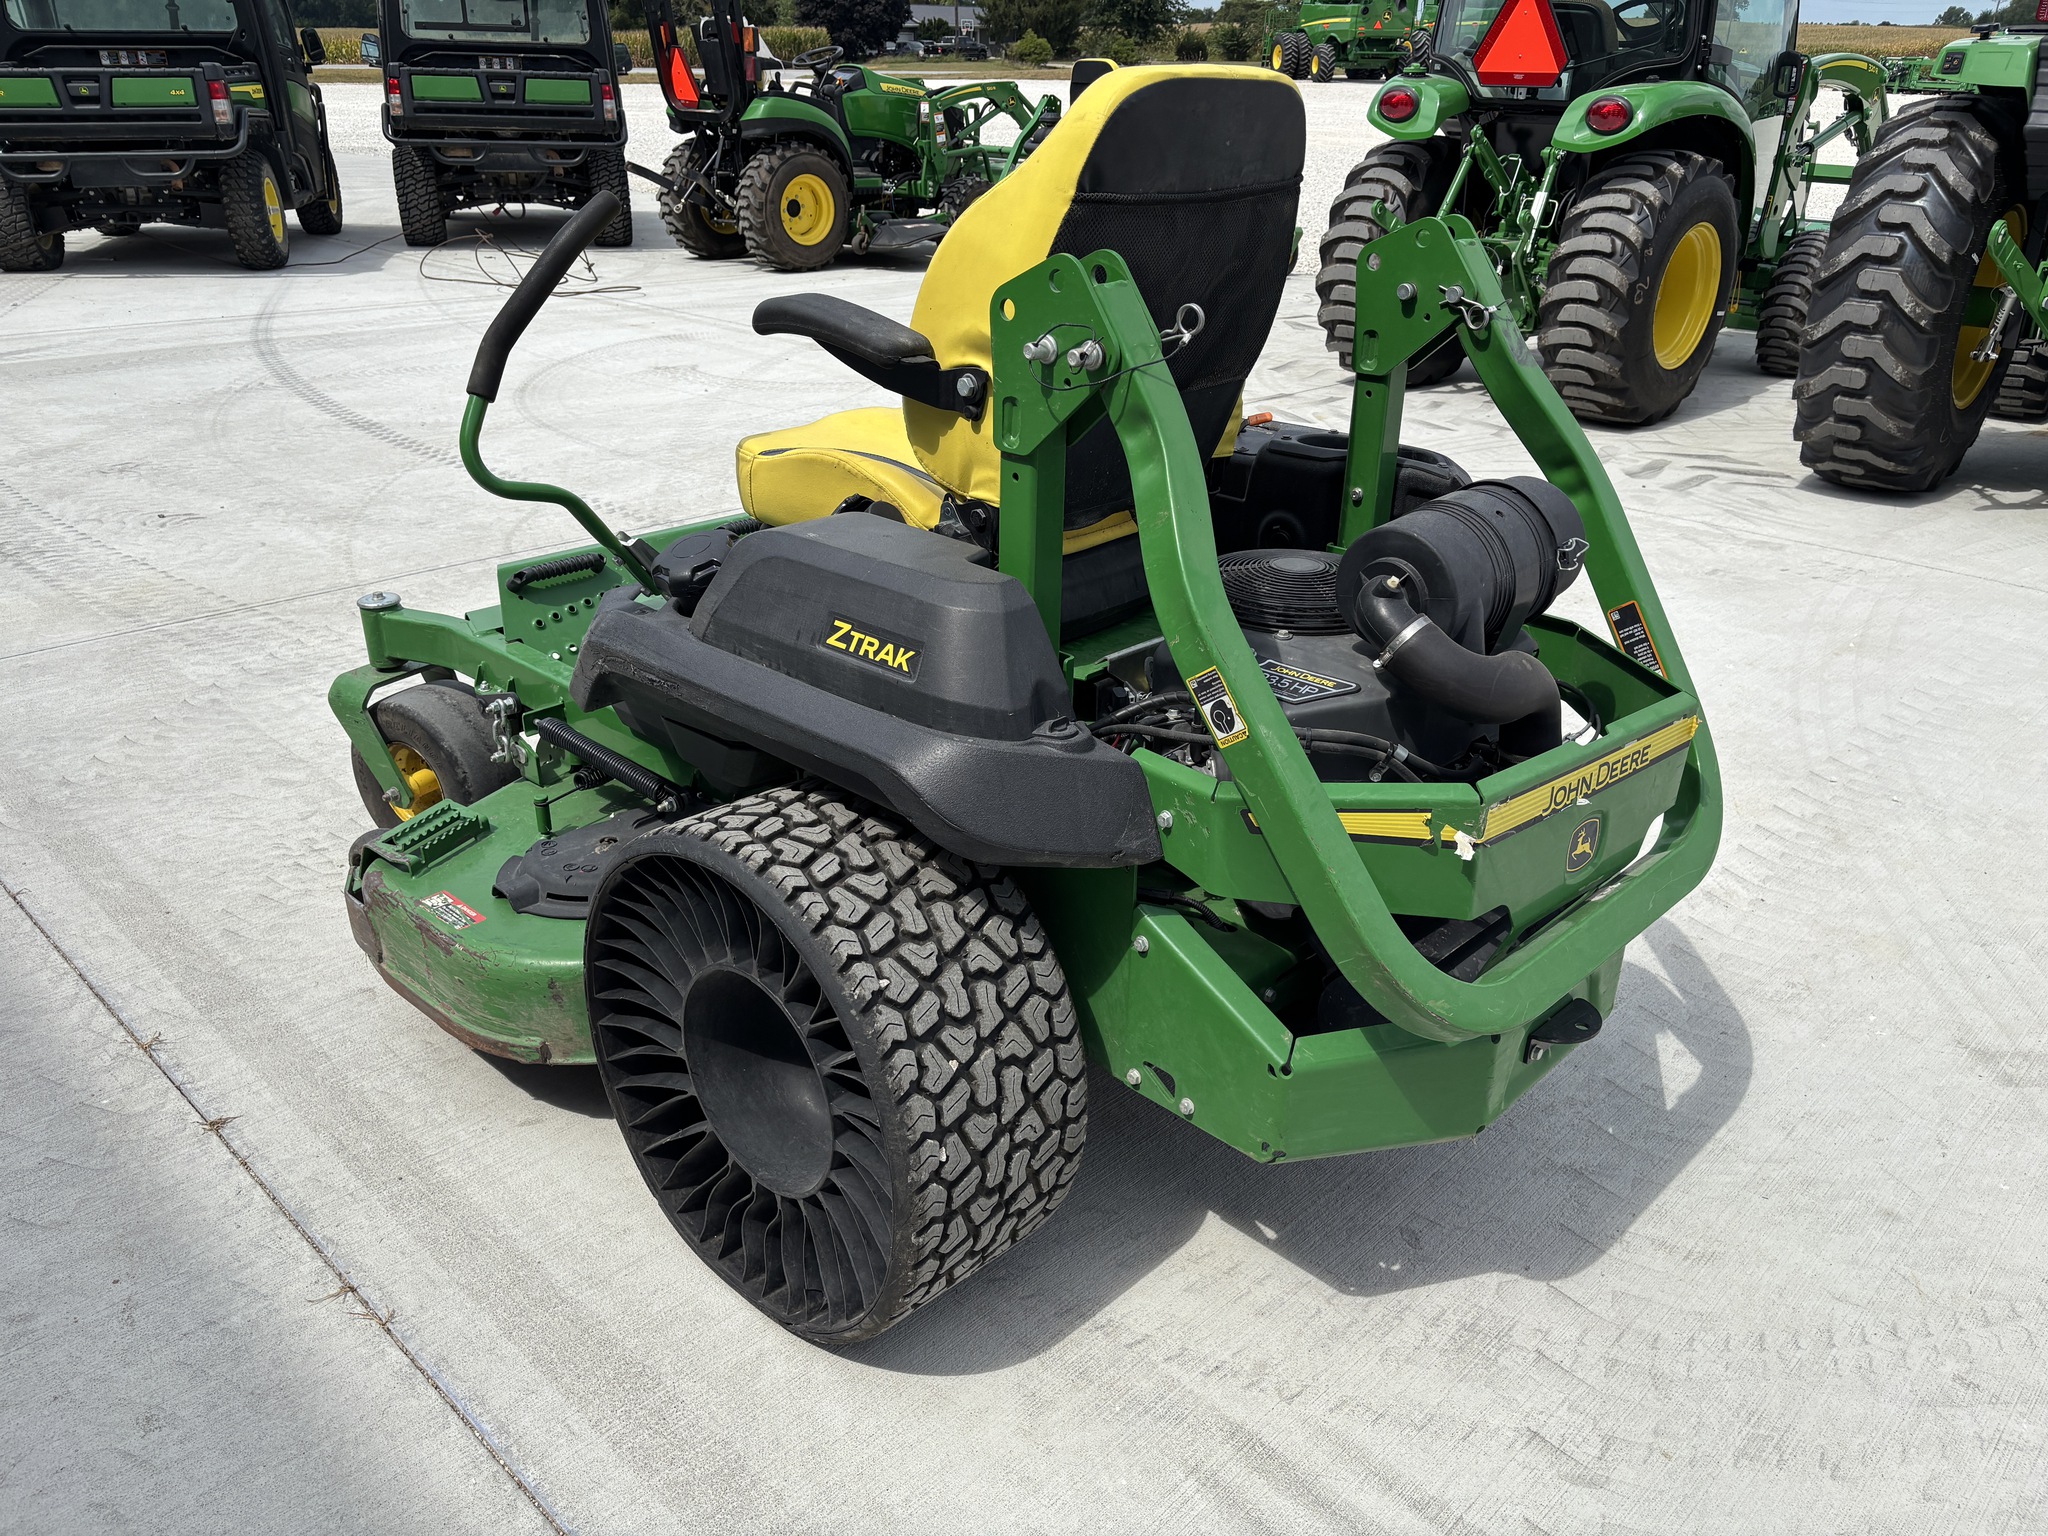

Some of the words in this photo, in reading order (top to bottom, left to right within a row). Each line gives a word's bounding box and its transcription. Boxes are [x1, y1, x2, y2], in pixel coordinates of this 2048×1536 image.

[826, 620, 916, 672] ZTRAK
[1270, 665, 1301, 678] JOHN
[1300, 673, 1337, 688] DEERE
[1290, 682, 1319, 694] HP
[1541, 772, 1594, 813] JOHN
[1595, 744, 1652, 788] DEERE
